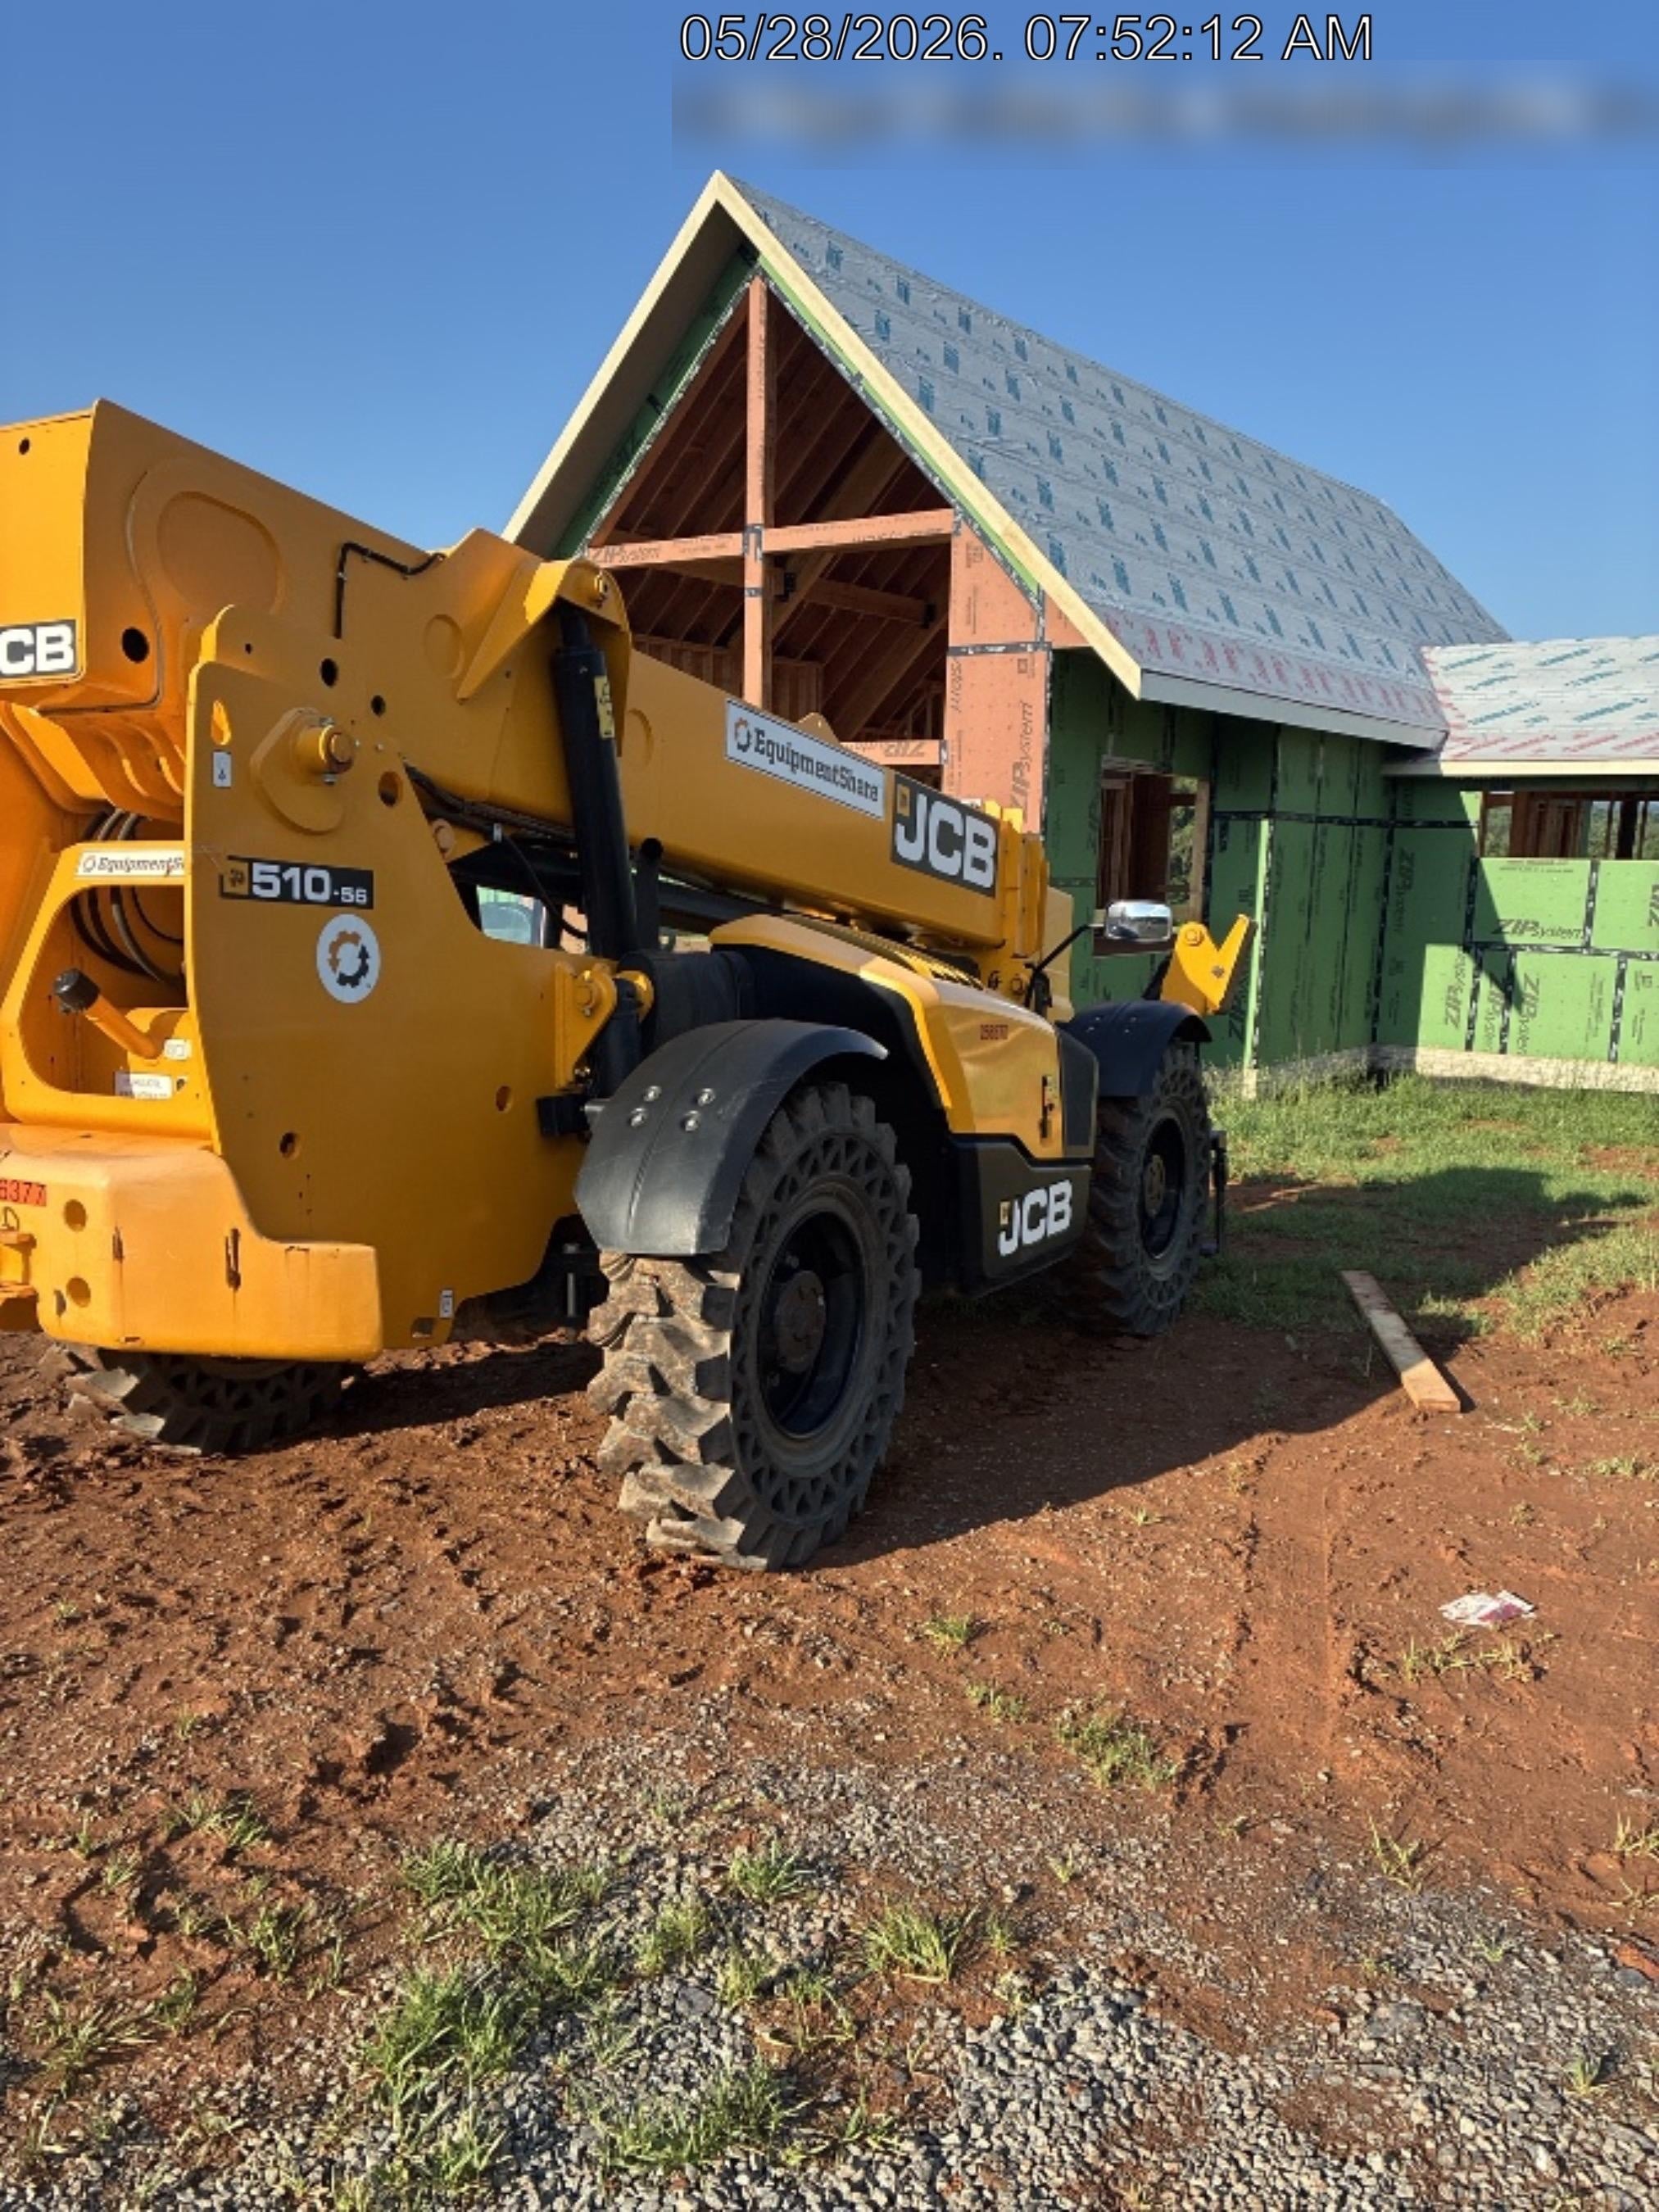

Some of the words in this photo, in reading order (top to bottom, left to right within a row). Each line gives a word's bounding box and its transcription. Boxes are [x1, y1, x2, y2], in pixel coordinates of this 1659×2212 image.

[754, 727, 879, 802] EquipmentShare
[895, 793, 996, 888] JCB
[252, 862, 367, 905] 510-56
[998, 1180, 1072, 1257] JCB
